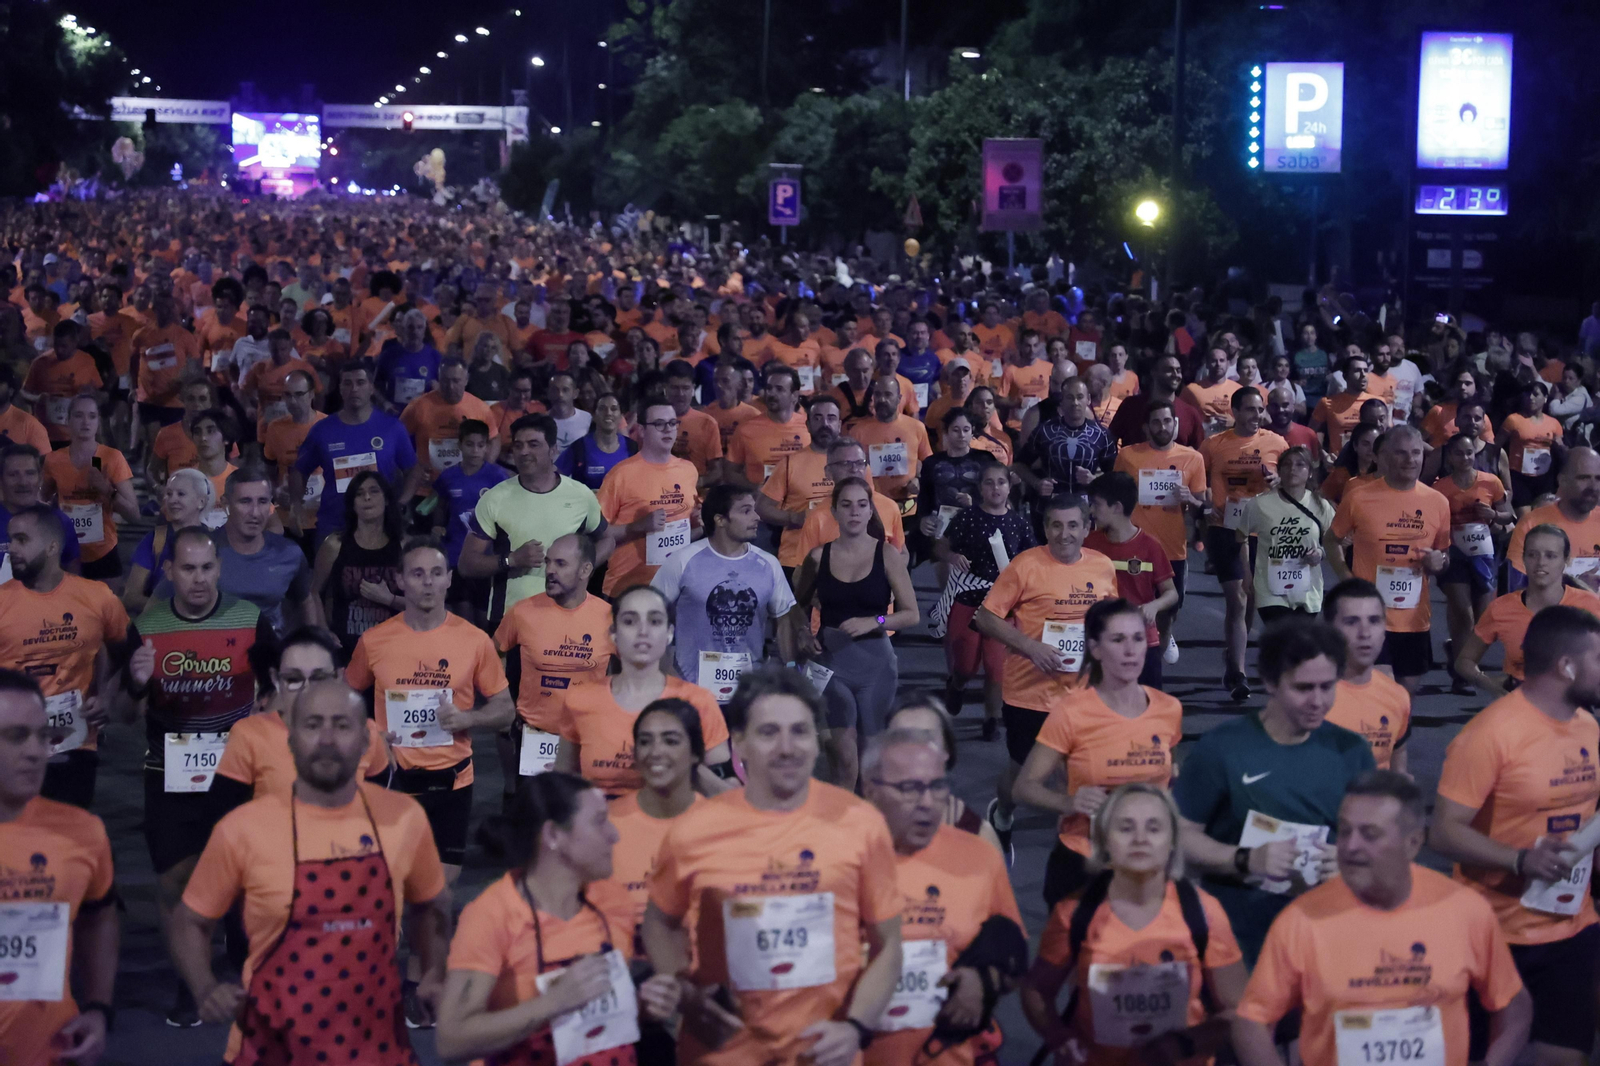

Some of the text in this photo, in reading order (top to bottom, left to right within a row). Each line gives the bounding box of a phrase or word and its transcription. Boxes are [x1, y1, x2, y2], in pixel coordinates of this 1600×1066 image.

[1285, 72, 1329, 134] P
[1303, 121, 1327, 135] 24h
[1277, 152, 1321, 169] saba
[776, 184, 793, 205] P
[437, 449, 460, 458] 20858
[878, 453, 902, 463] 14820
[1148, 481, 1174, 492] 13568
[1280, 517, 1301, 525] LAS
[1270, 526, 1310, 536] CHICAS
[1461, 533, 1485, 543] 14544
[657, 534, 685, 549] 20555
[1277, 536, 1302, 546] SON
[1277, 570, 1303, 580] 12766
[1389, 581, 1412, 592] 5501
[39, 625, 78, 637] NOCTURNA
[22, 633, 58, 647] SEVILLA
[1058, 639, 1085, 653] 9028
[542, 649, 575, 660] SEVILLA
[558, 644, 594, 654] NOCTURNA
[161, 650, 232, 676] Gorras
[413, 671, 451, 680] NOCTURNA
[714, 667, 741, 682] 8905
[160, 674, 234, 694] runners
[395, 678, 430, 687] SEVILLA
[403, 708, 436, 724] 2693
[183, 753, 217, 767] 7150
[1567, 867, 1587, 885] 87
[756, 927, 808, 952] 6749
[1112, 991, 1171, 1013] 10803
[1361, 1036, 1425, 1063] 13702
